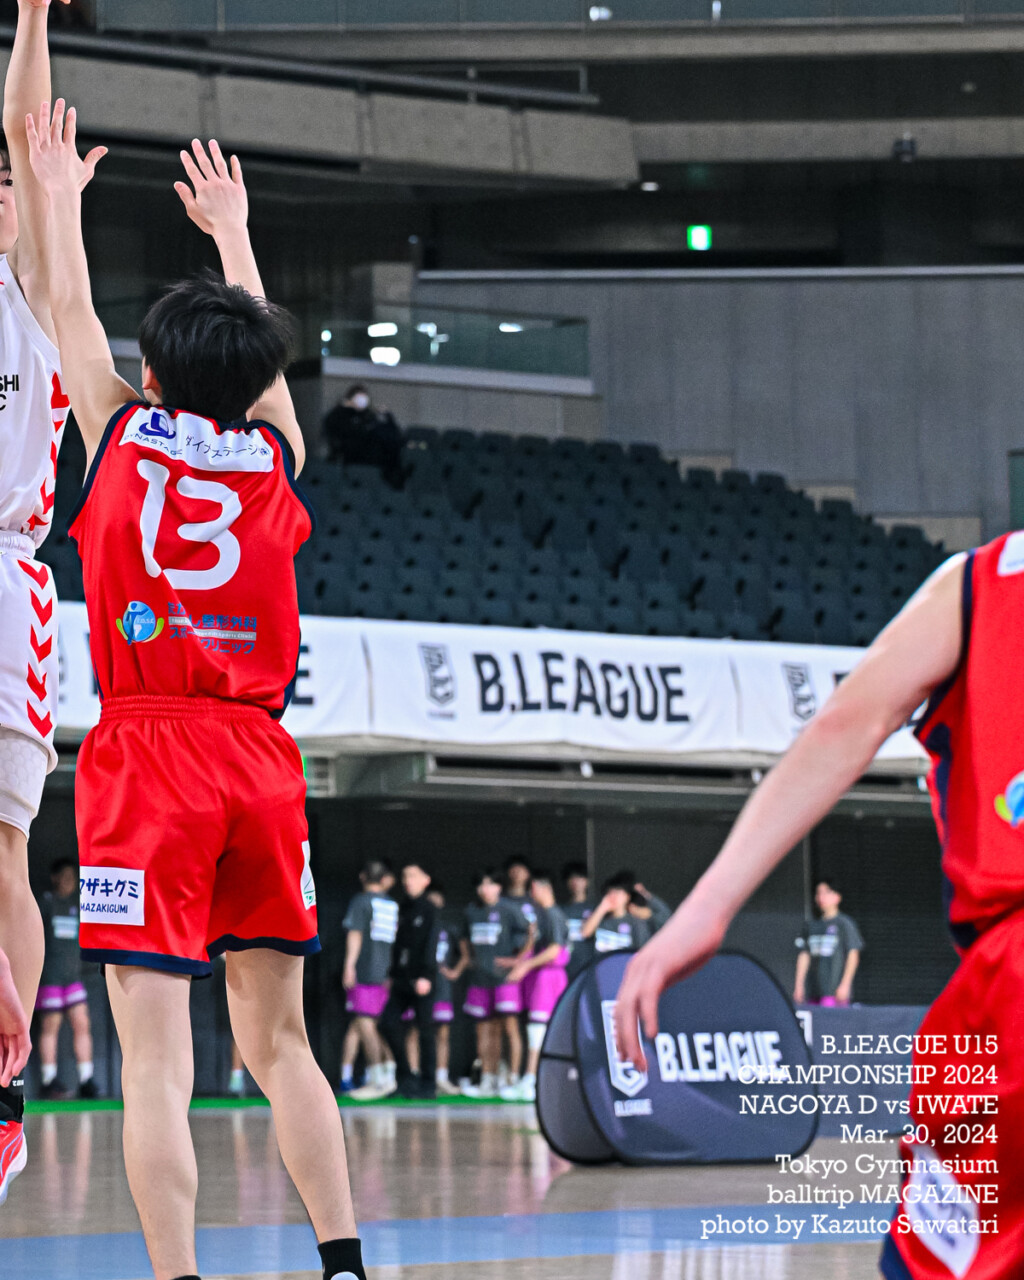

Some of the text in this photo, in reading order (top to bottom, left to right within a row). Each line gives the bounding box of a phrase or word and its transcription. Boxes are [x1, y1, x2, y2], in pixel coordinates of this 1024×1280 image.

[137, 459, 243, 590] 13
[170, 626, 255, 654] スポークリニック
[473, 651, 690, 722] B.LEAGUE
[655, 1031, 789, 1083] B.LEAGUE
